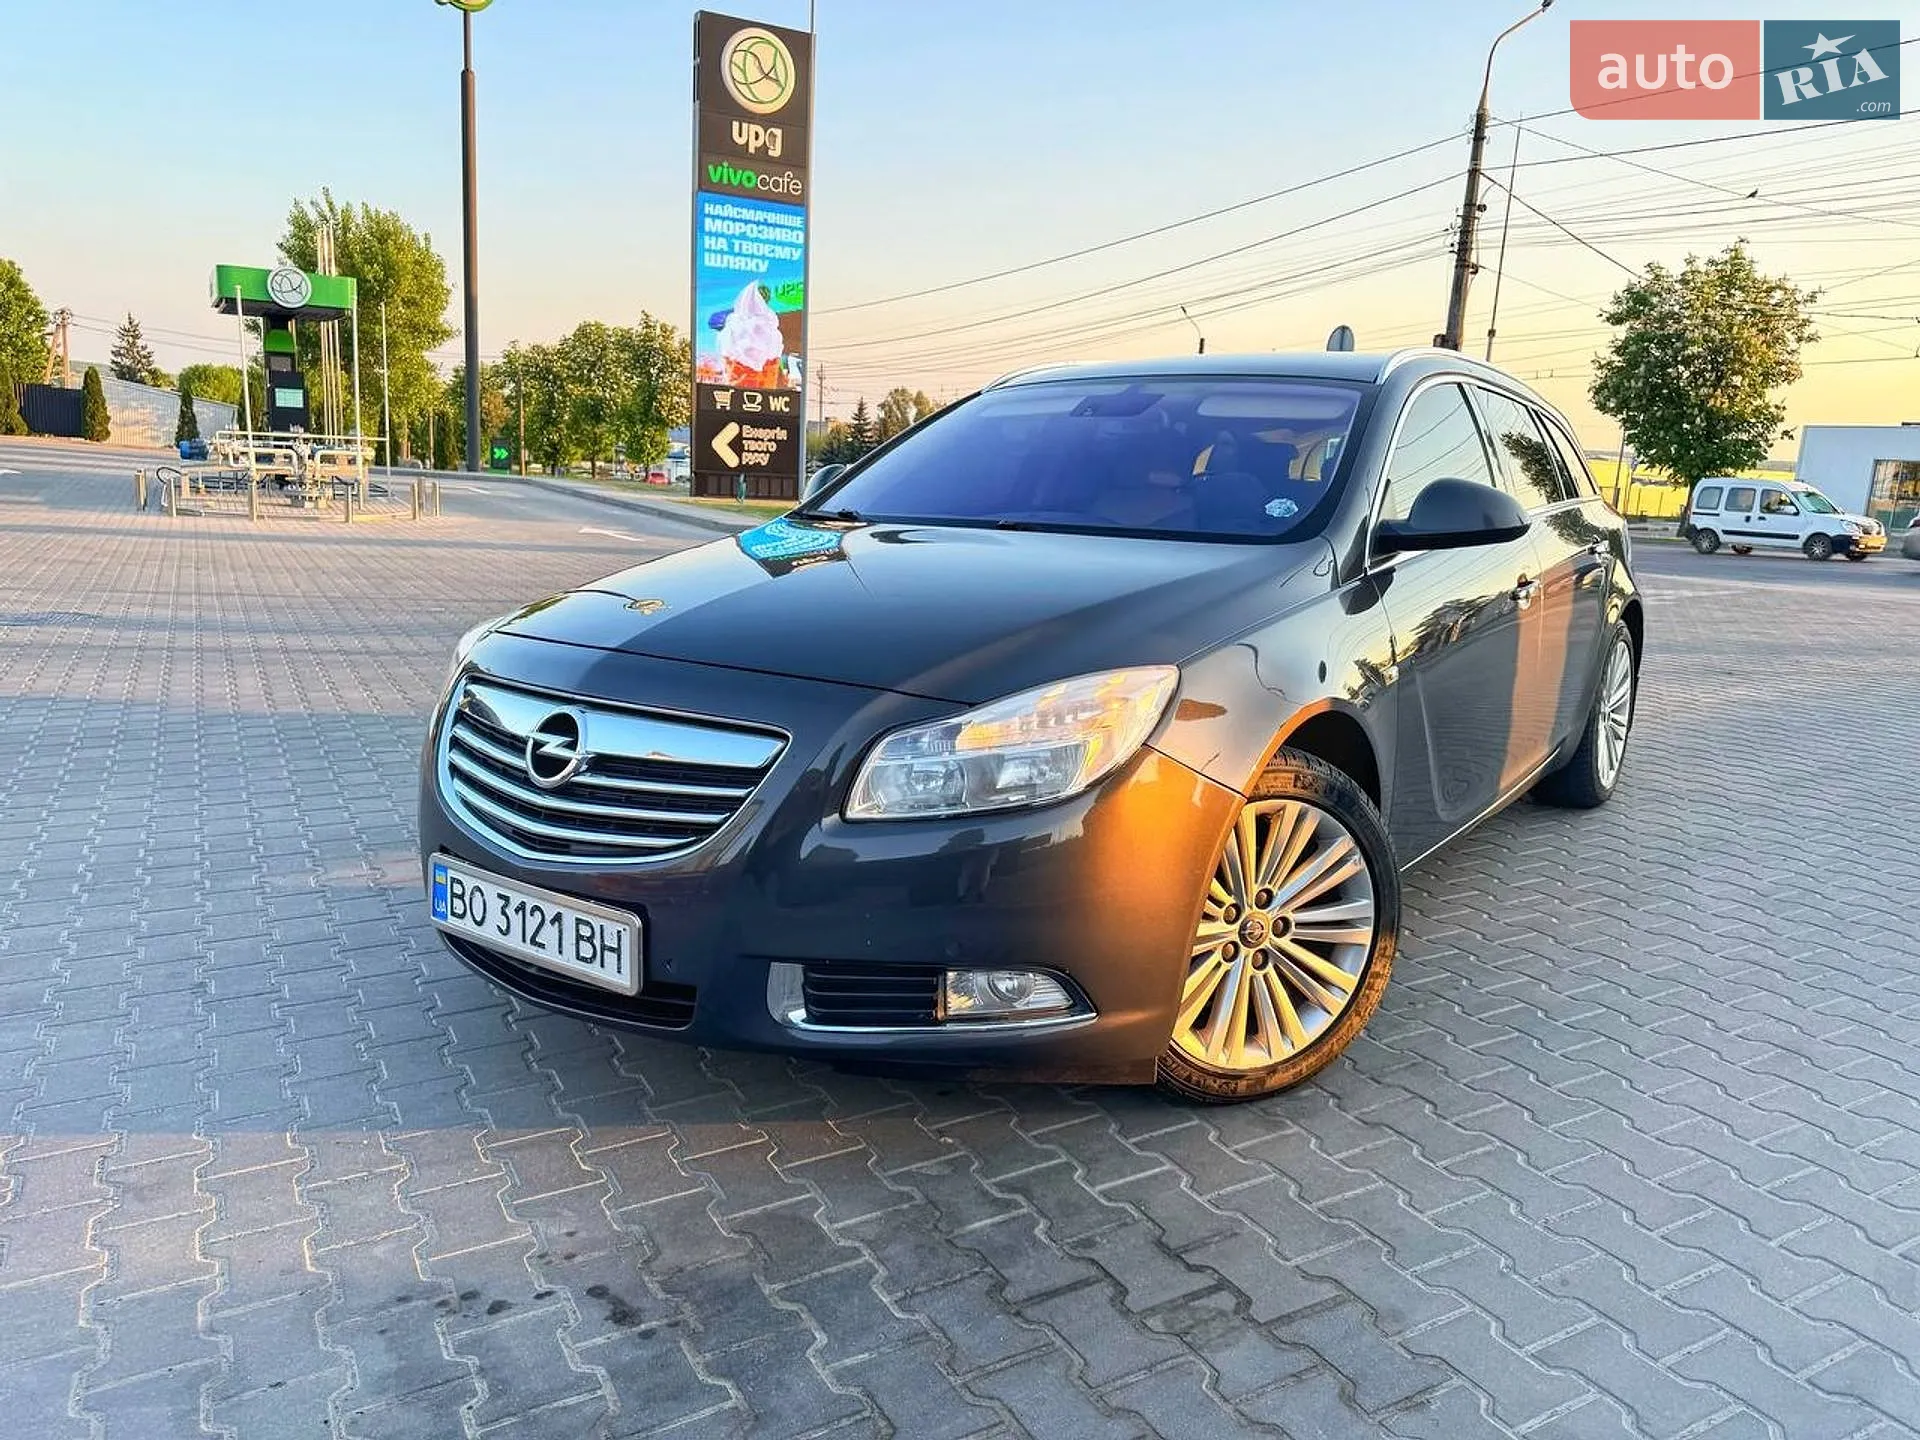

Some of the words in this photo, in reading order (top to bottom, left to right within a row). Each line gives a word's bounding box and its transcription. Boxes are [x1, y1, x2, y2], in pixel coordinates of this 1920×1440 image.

[732, 120, 782, 157] upg
[704, 217, 804, 244] МОРОЗИВО
[704, 235, 728, 252] НА
[704, 251, 769, 273] ШЛЯХУ
[769, 395, 790, 412] WC
[434, 901, 446, 914] UA
[450, 876, 487, 926] BO
[496, 892, 563, 955] 3121
[574, 916, 622, 974] BH
